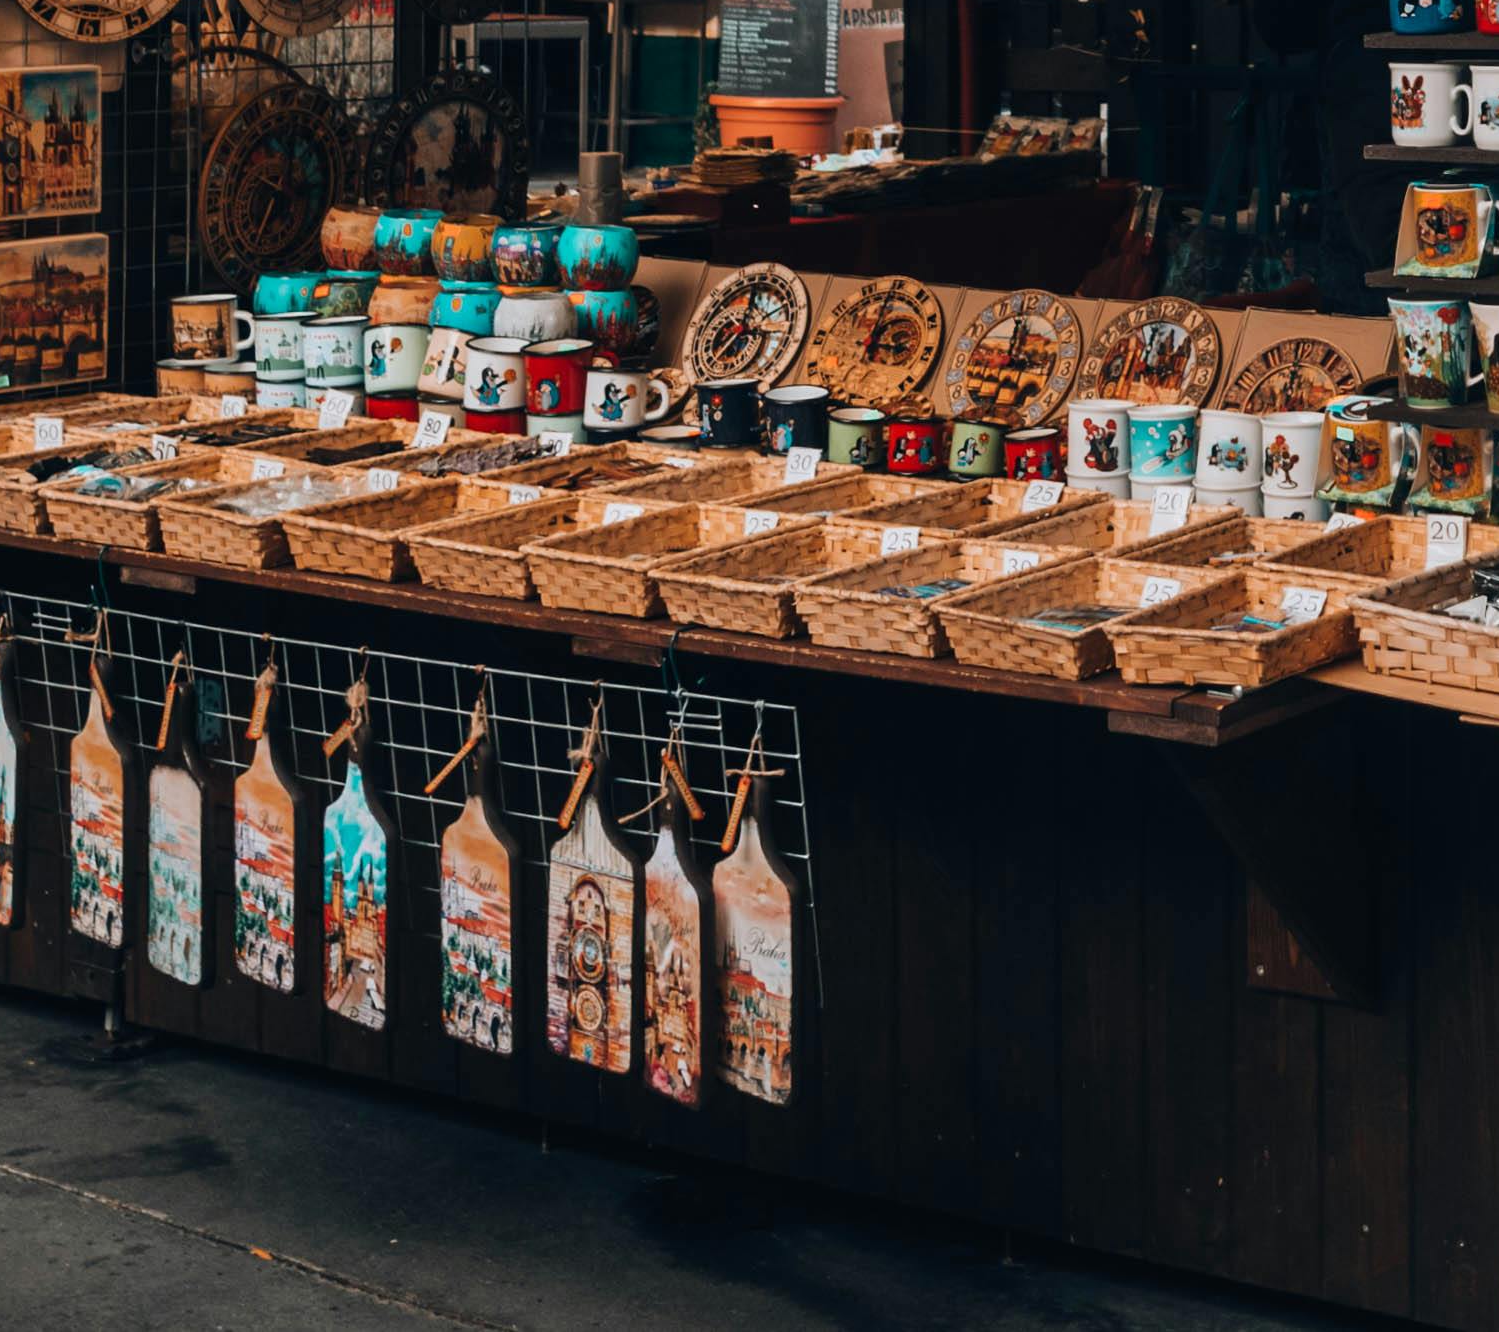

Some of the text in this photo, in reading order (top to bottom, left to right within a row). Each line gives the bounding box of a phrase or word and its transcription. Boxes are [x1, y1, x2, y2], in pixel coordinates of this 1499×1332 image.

[326, 398, 347, 415] 60
[39, 424, 60, 440] 60
[424, 418, 442, 434] 80
[155, 441, 177, 460] 50
[789, 454, 812, 472] 30
[372, 472, 393, 490] 40
[1030, 484, 1055, 502] 25
[1157, 493, 1183, 512] 20
[748, 517, 771, 536] 25
[1431, 520, 1460, 540] 20
[886, 531, 913, 552] 25
[1145, 583, 1173, 603] 25
[1289, 594, 1318, 613] 25
[470, 865, 498, 893] Praha
[742, 926, 788, 961] Praha
